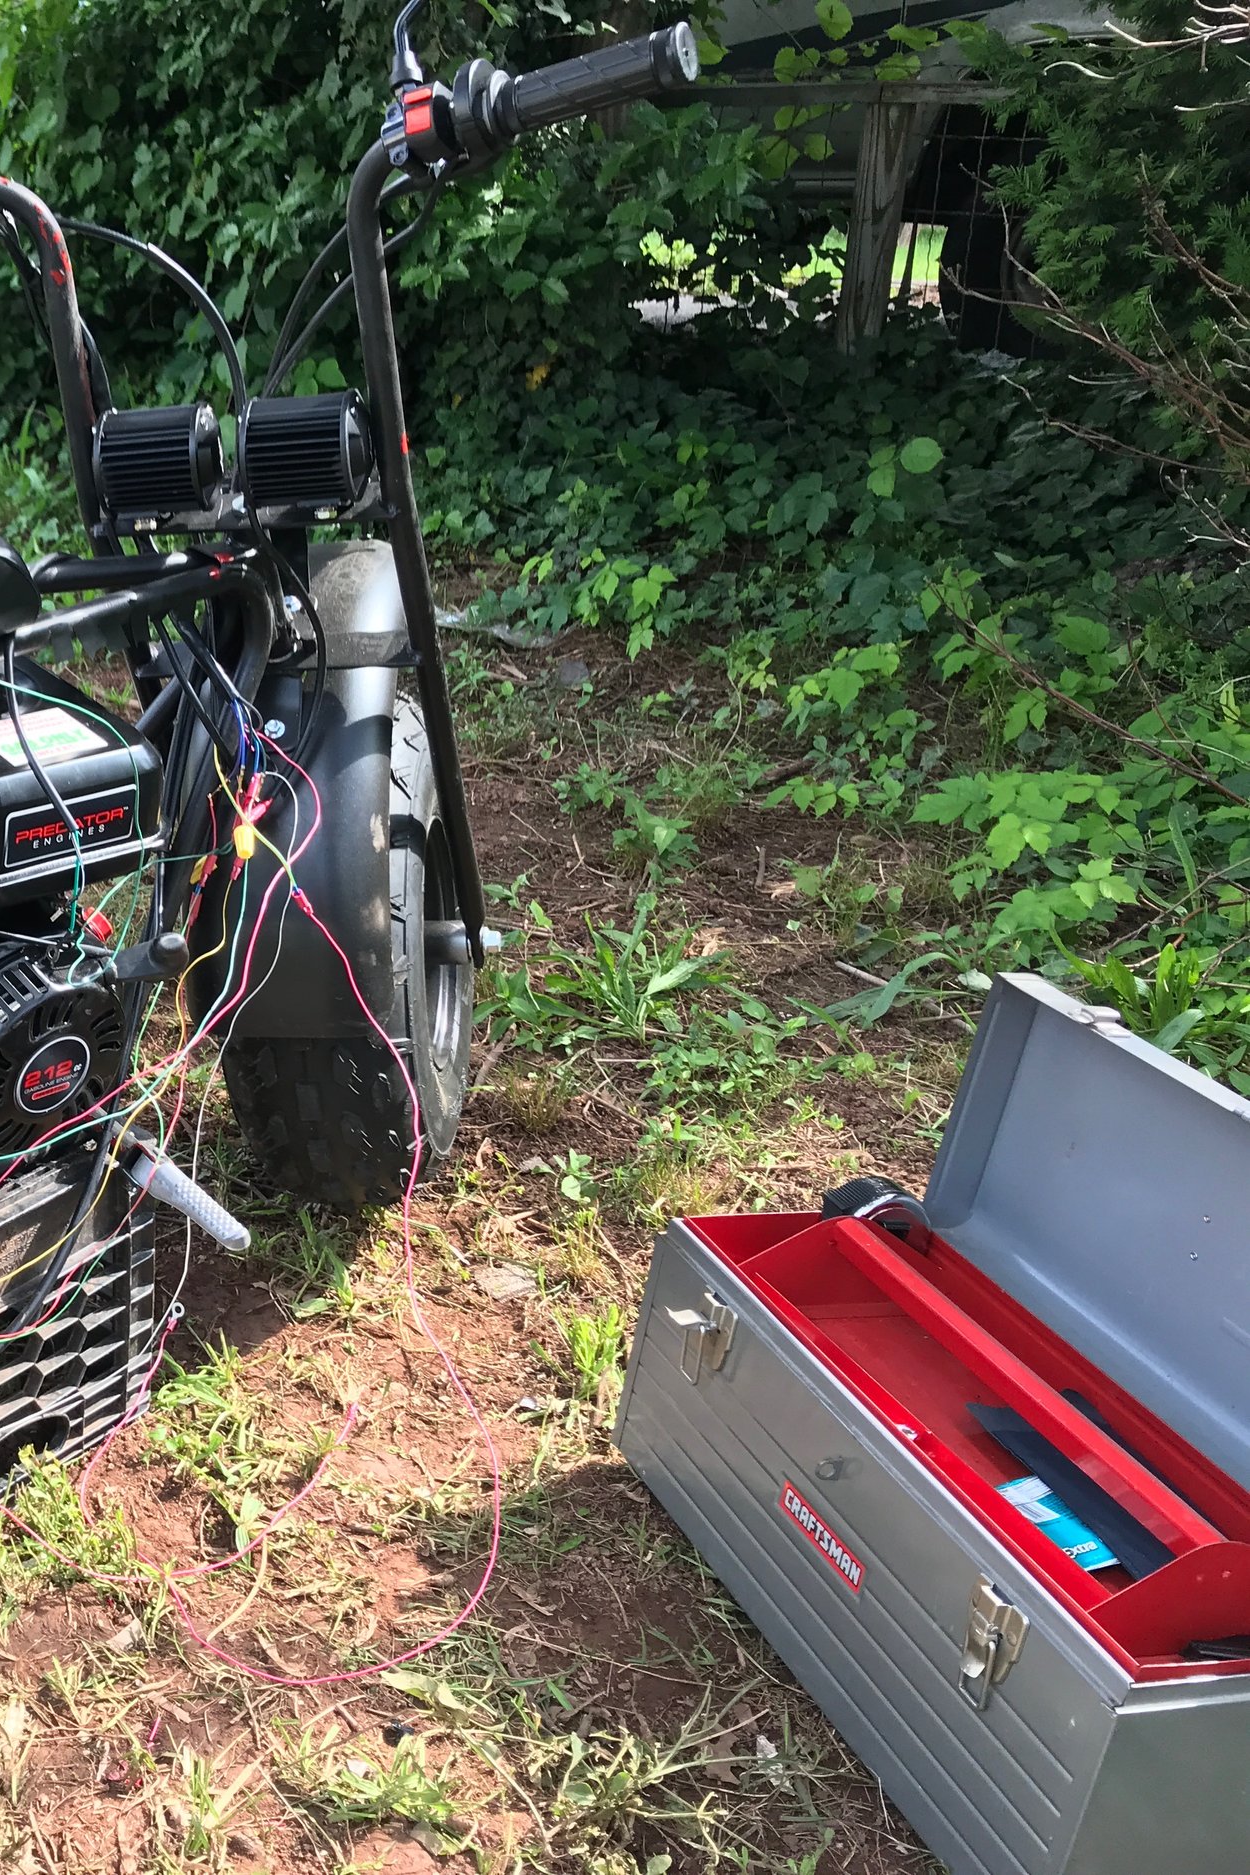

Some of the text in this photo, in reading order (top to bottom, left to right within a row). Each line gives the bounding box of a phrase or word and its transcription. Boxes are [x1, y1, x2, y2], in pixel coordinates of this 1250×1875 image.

[24, 1059, 73, 1088] 212
[784, 1488, 861, 1586] CRAFTSMAN
[1063, 1540, 1099, 1559] Extra
